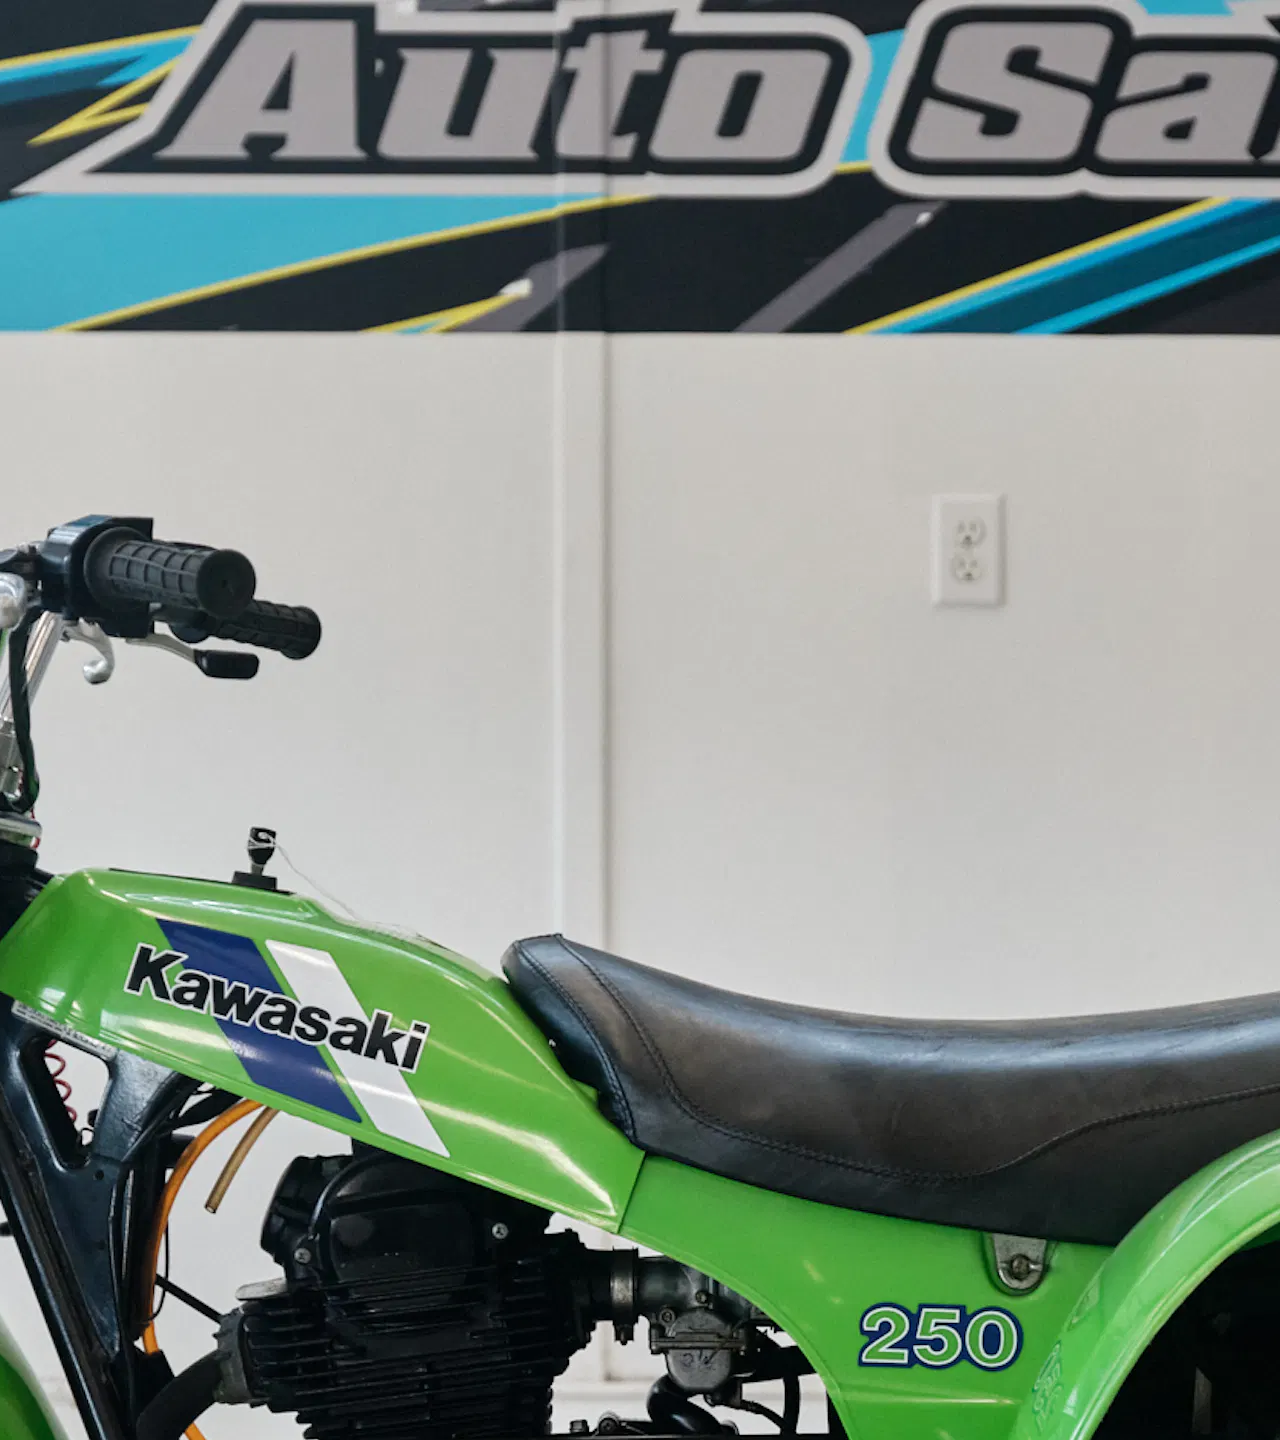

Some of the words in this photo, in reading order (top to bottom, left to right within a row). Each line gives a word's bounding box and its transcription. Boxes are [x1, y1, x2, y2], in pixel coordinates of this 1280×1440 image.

[115, 4, 850, 173] Auto
[124, 943, 430, 1073] Kawasaki
[859, 1303, 1022, 1371] 250
